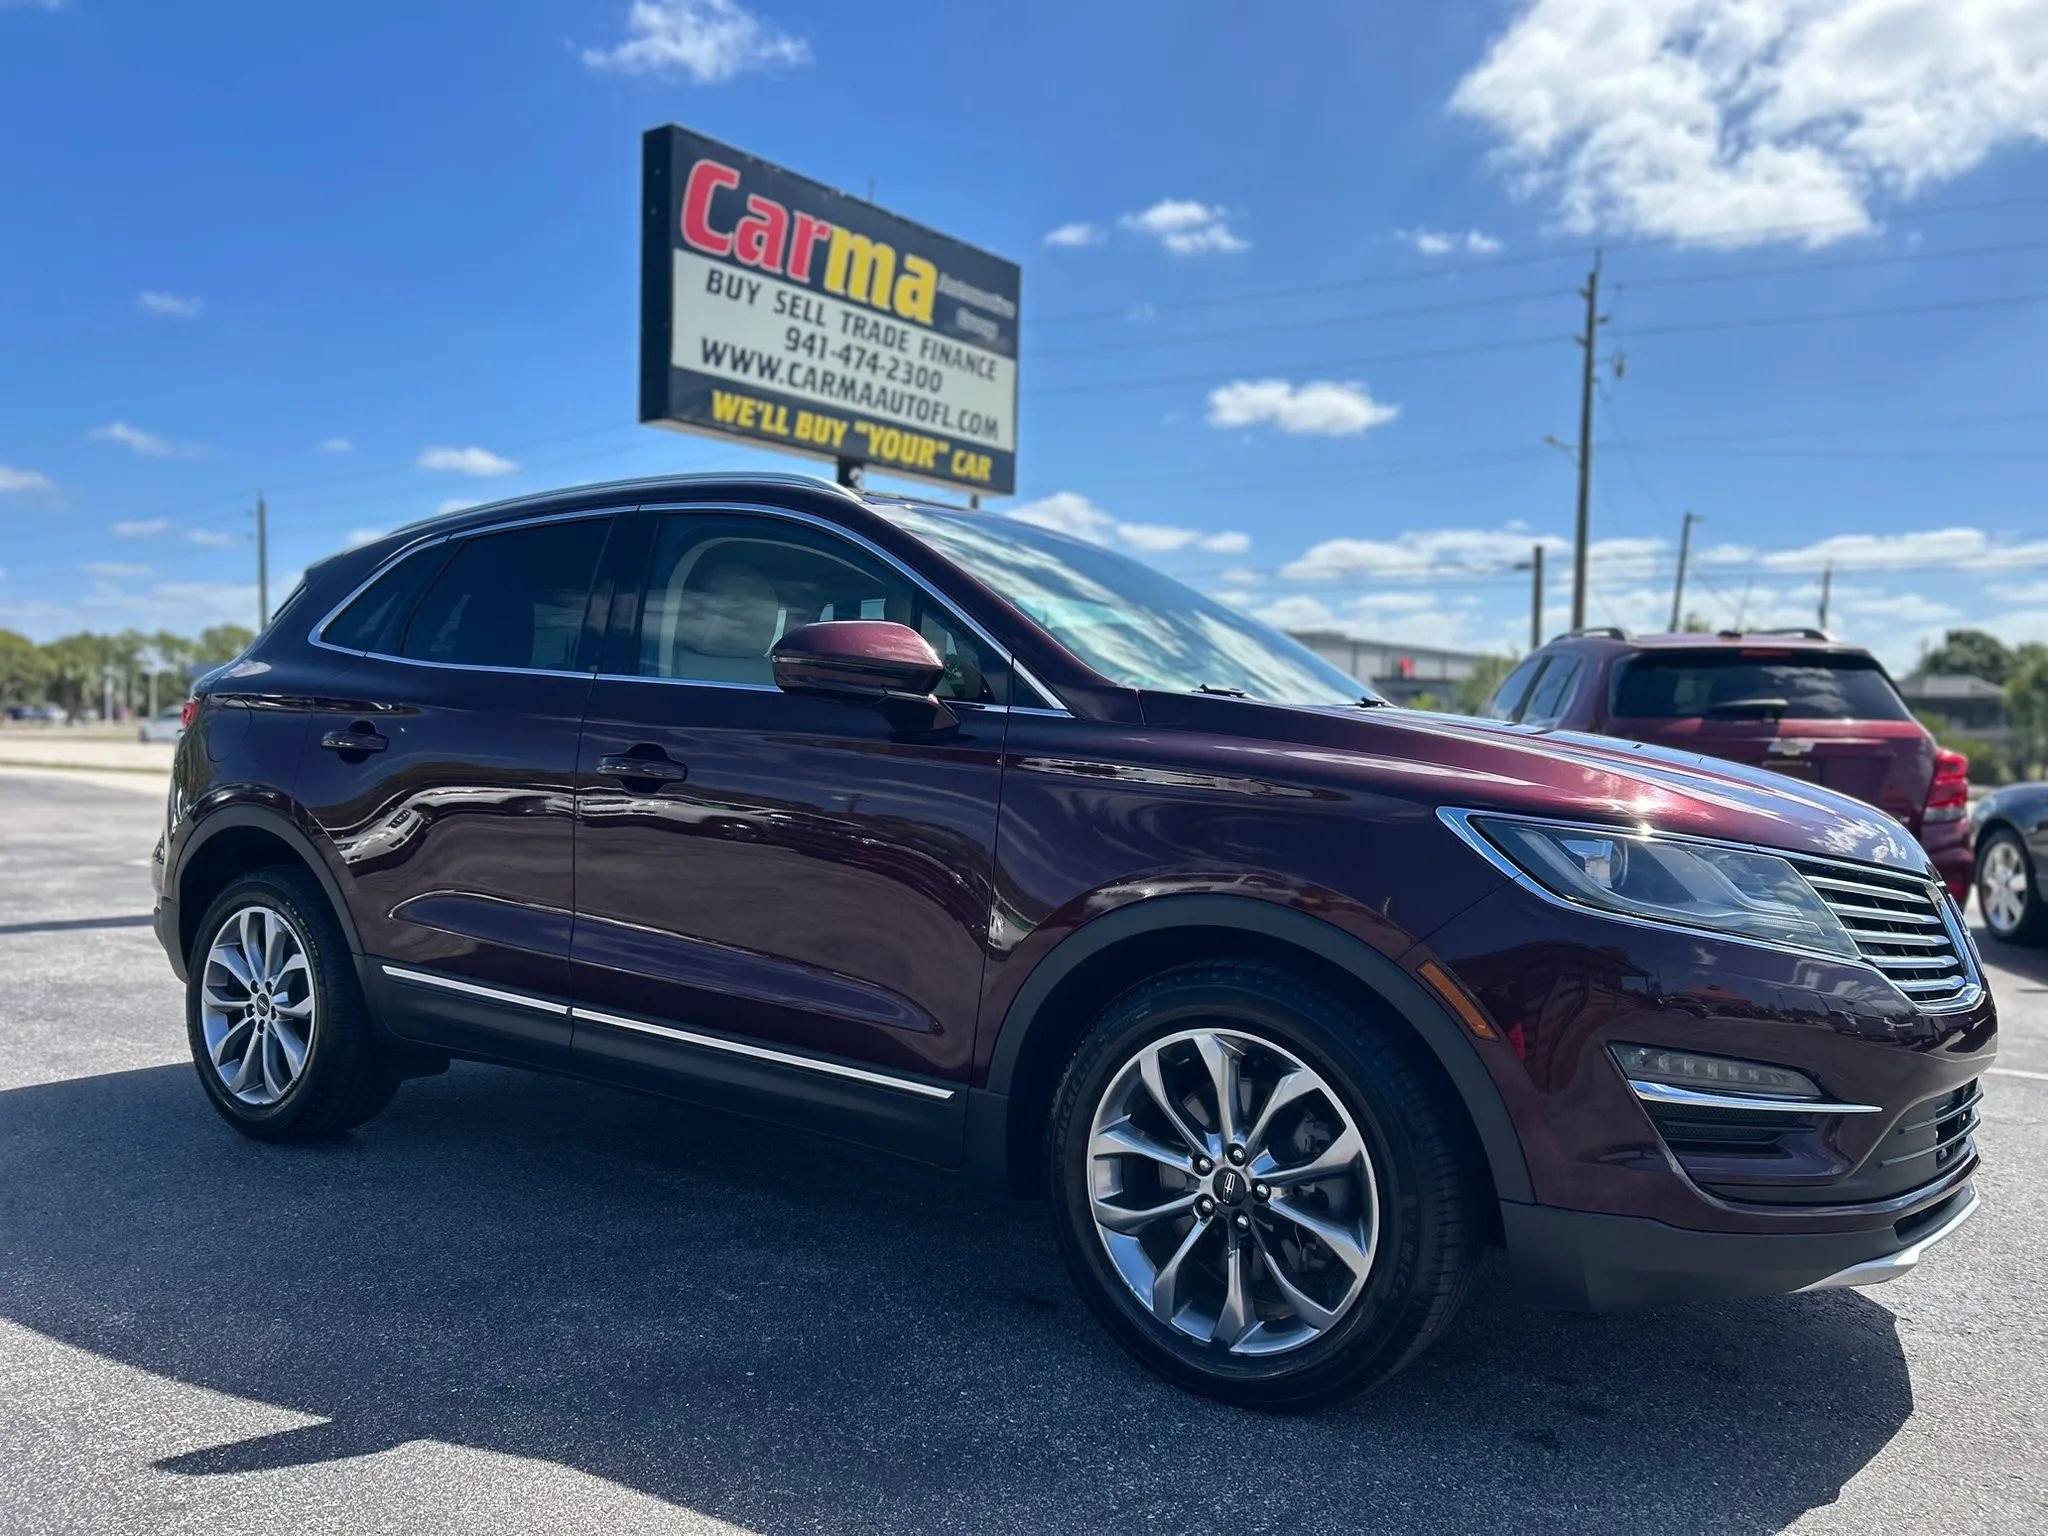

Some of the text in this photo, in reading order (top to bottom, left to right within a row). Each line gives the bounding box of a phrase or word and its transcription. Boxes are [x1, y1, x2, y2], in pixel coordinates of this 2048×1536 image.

[681, 159, 934, 325] Carma
[705, 269, 761, 305] BUY
[773, 290, 827, 327] SELL
[841, 312, 910, 352] TRADE
[920, 338, 997, 381] FINANCE
[784, 326, 943, 393] 941-474-2300
[701, 337, 998, 440] WWW.CARMAAUTOFL.COM
[711, 389, 992, 482] WE'LL BUY "YOUR" CAR
